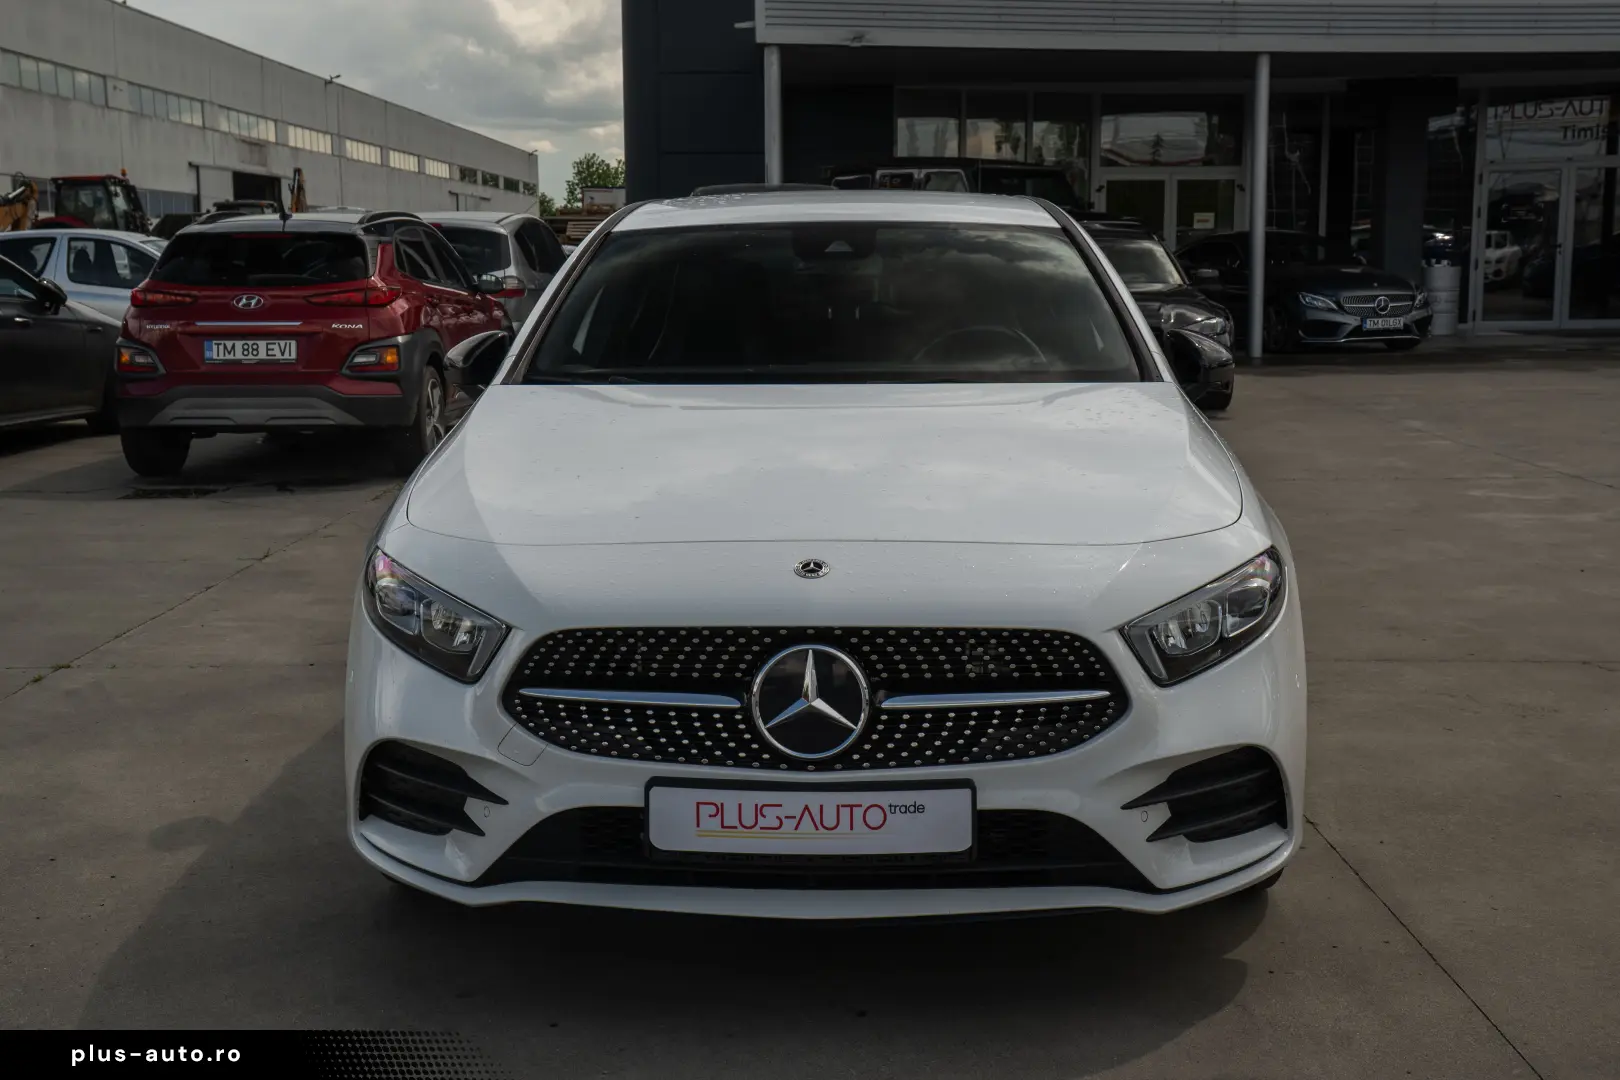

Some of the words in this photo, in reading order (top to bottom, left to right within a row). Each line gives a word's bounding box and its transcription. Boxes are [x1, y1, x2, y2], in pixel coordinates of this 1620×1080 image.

[214, 342, 236, 358] TM
[241, 342, 260, 358] 88
[266, 342, 292, 358] EVI
[695, 801, 888, 831] PLUS-AUTO
[888, 800, 926, 815] trade
